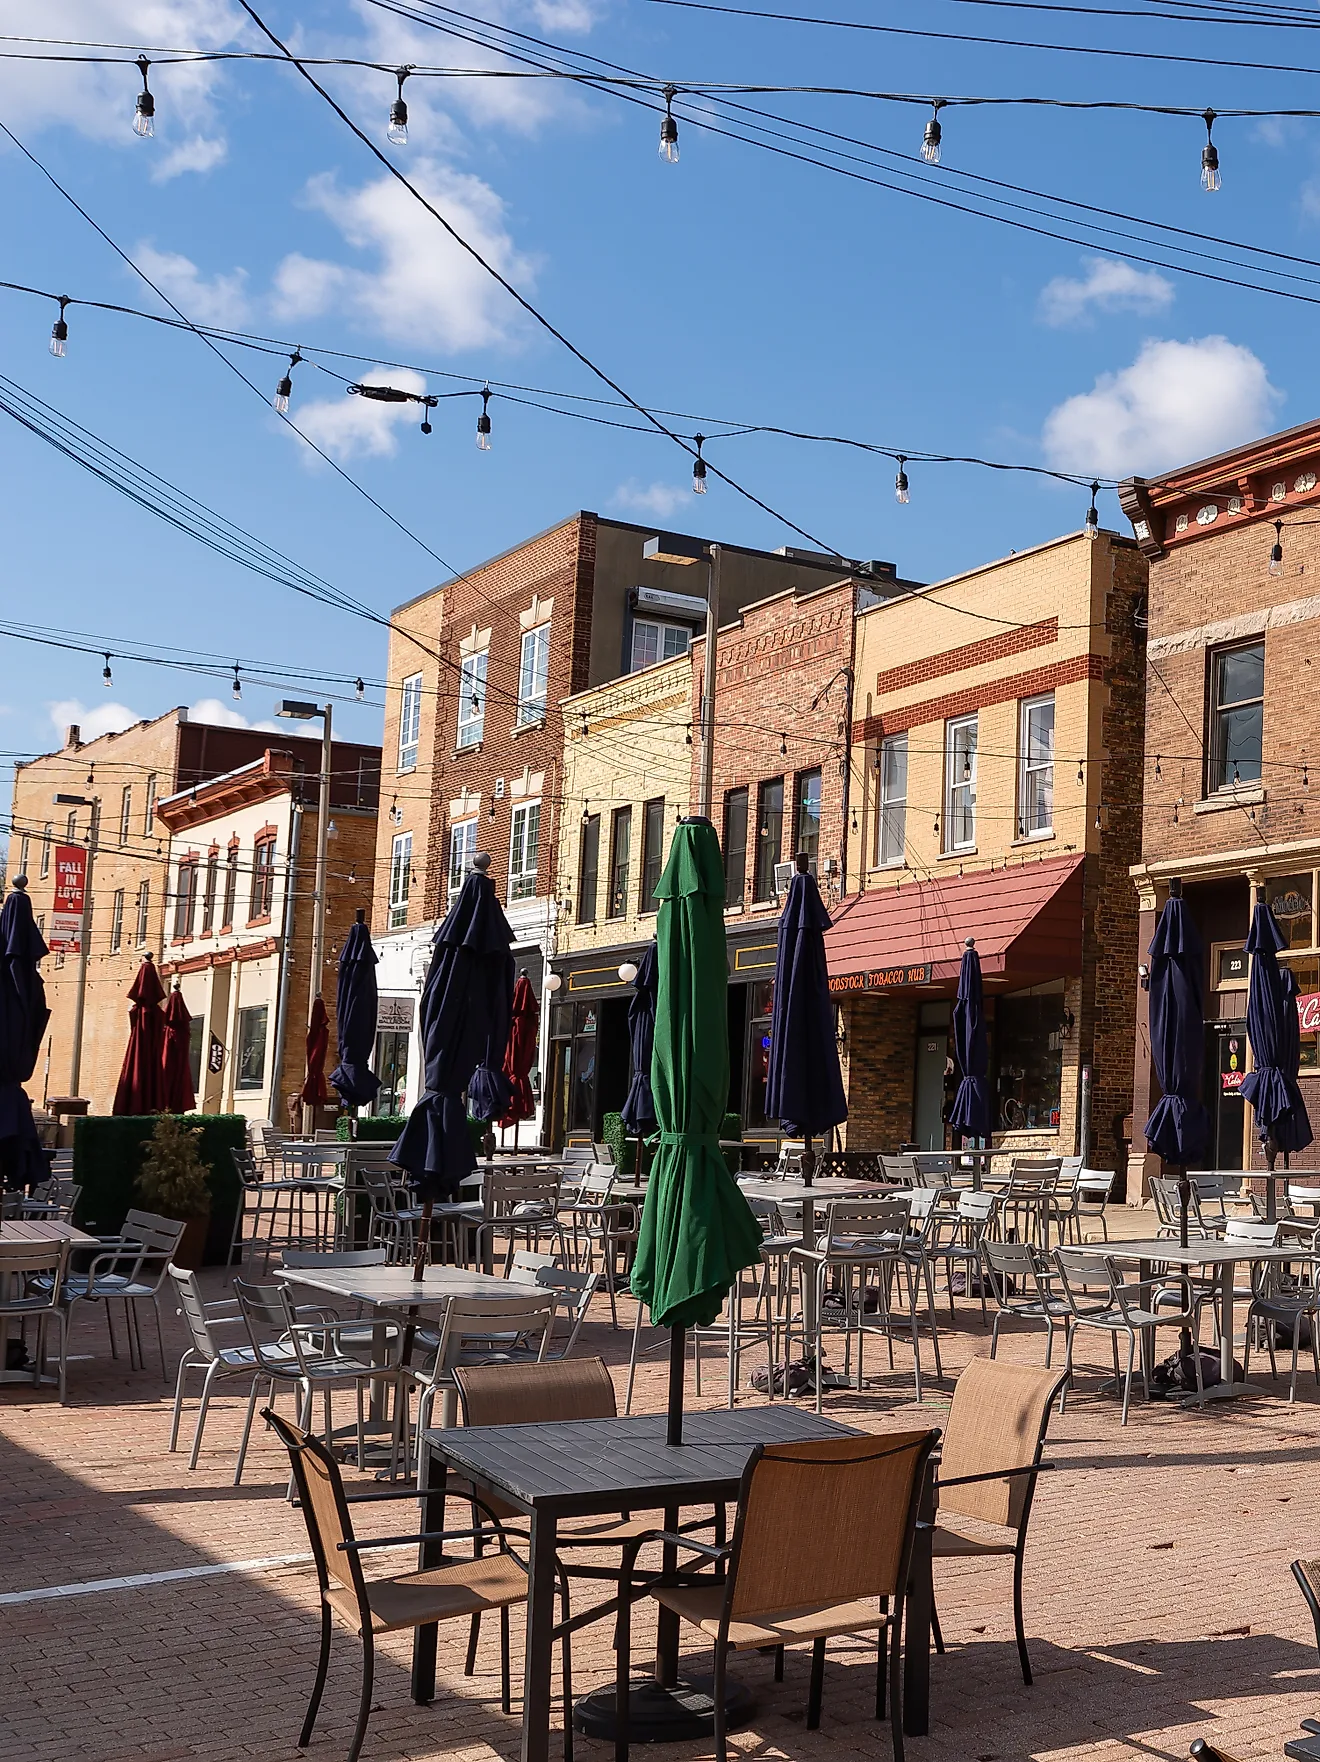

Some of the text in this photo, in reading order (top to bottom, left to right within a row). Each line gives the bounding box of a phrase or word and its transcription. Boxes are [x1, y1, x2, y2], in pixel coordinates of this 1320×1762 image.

[59, 861, 83, 874] FALL
[65, 874, 77, 886] IN
[57, 886, 82, 900] LOVE
[1230, 960, 1242, 970] 223
[869, 970, 905, 987] TOBACCO
[908, 967, 925, 982] HUB
